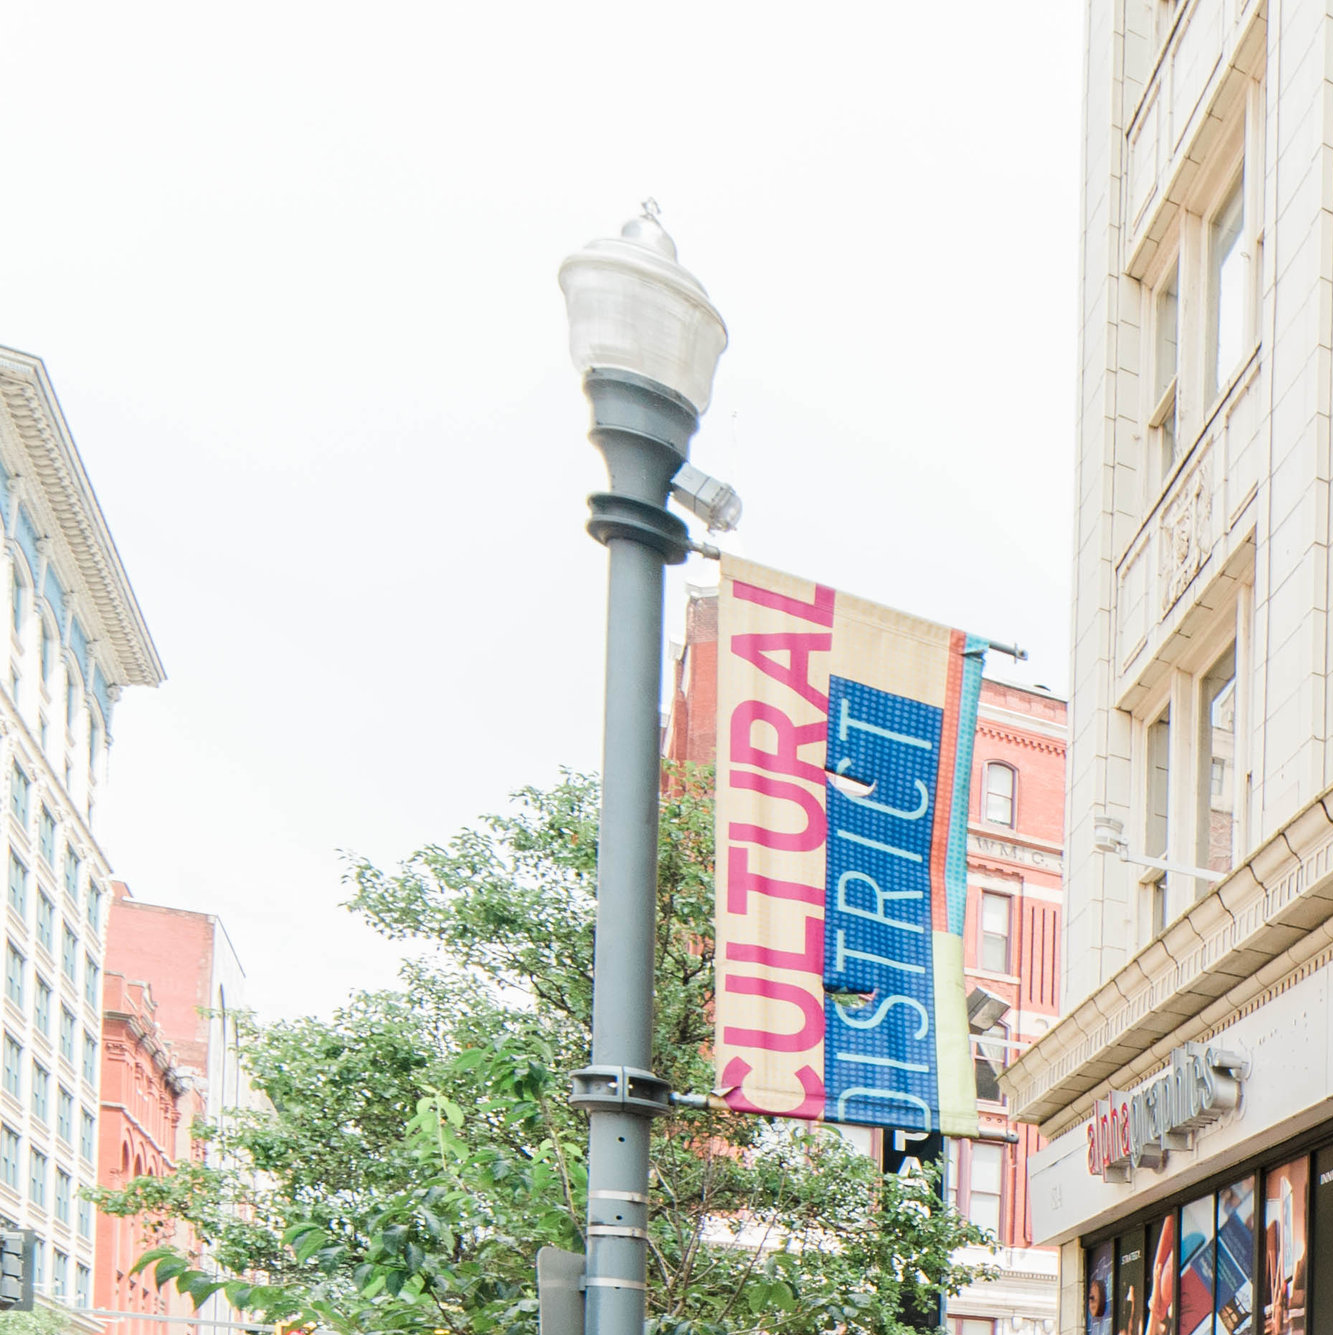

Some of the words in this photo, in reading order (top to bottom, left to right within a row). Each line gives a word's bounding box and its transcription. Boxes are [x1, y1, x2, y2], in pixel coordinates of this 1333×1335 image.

[719, 579, 836, 1121] CULTURAL
[836, 698, 933, 1131] DISTRICT
[1087, 1041, 1228, 1184] alphagraphics
